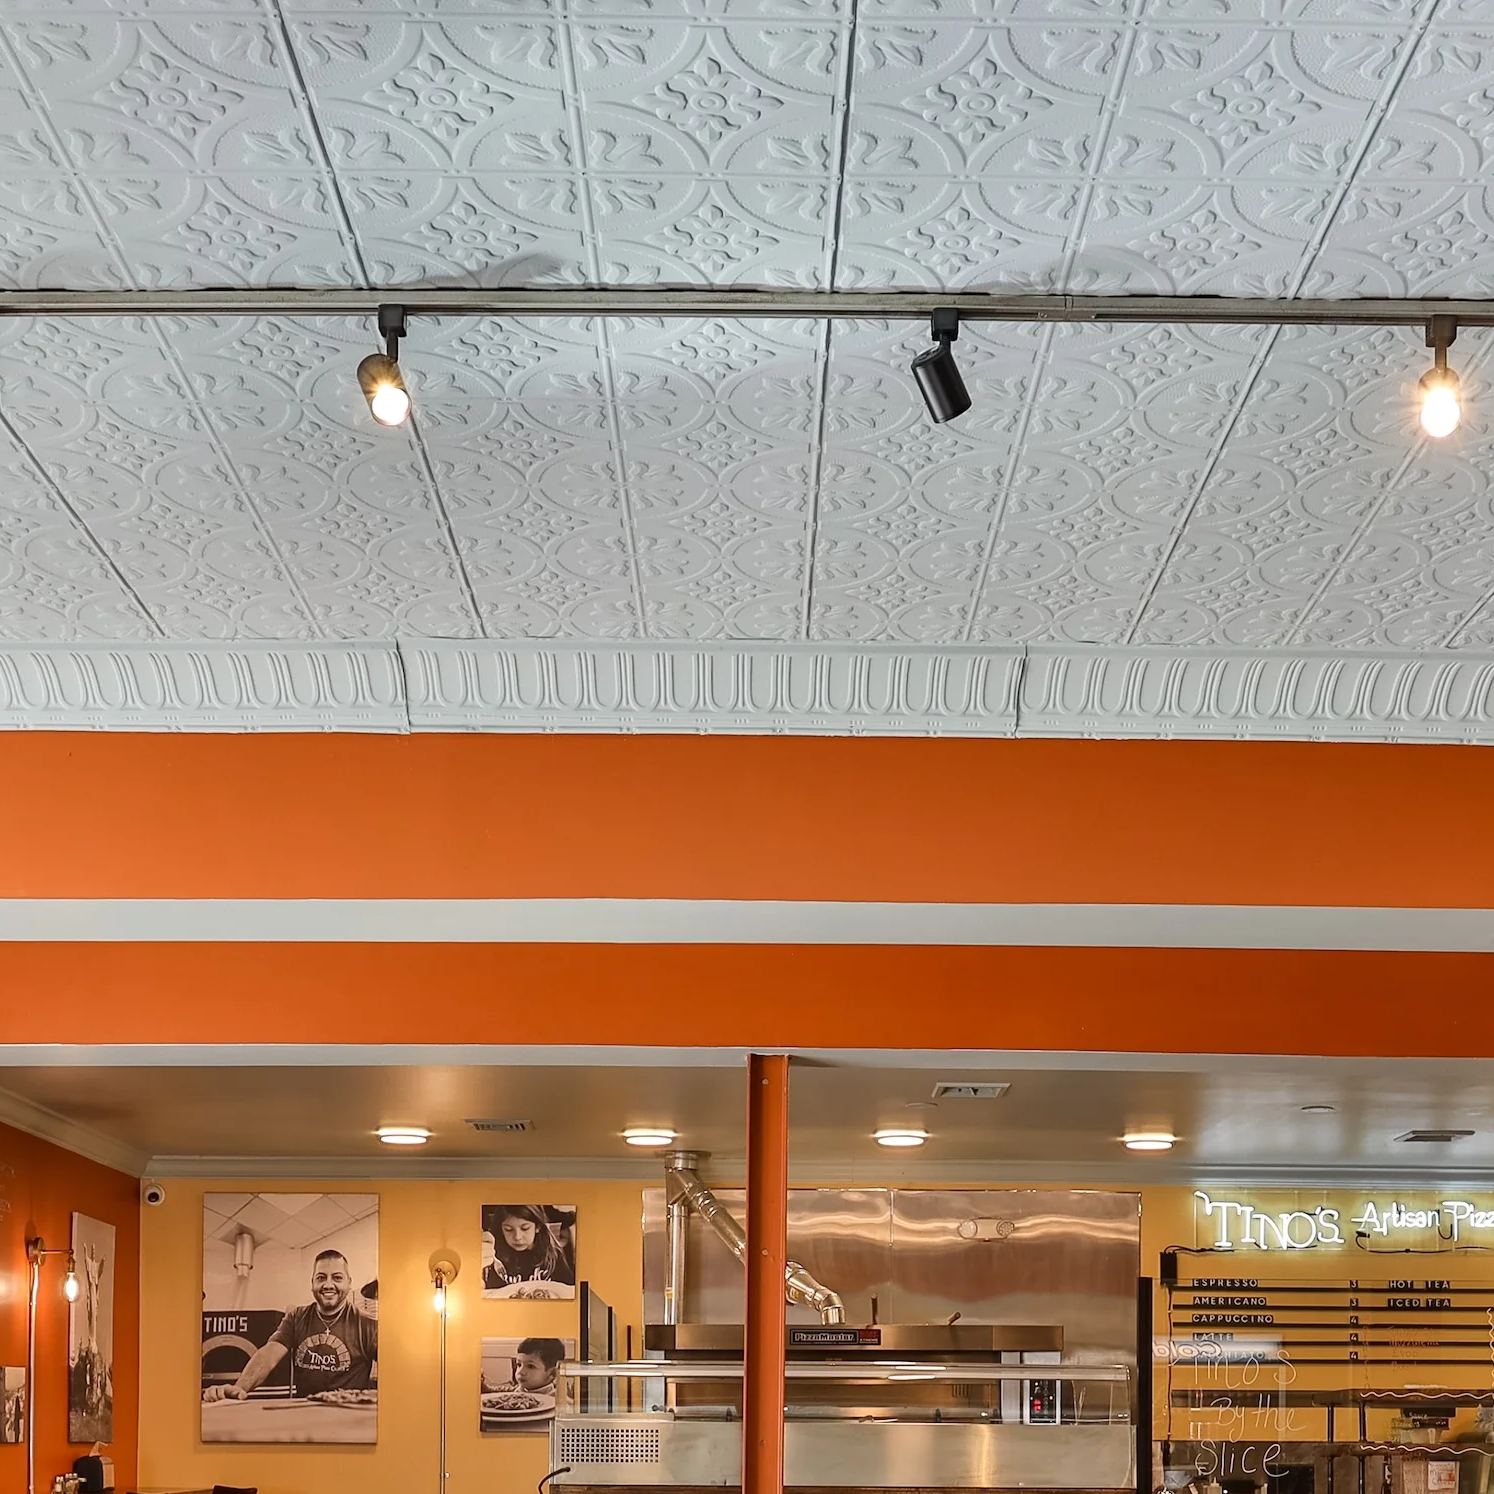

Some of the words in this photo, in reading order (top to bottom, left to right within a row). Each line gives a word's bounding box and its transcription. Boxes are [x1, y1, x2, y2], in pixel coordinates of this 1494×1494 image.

[1193, 1190, 1345, 1250] TINO'S
[1350, 1201, 1440, 1236] Artisan
[1192, 1279, 1257, 1287] ESPRESSO
[1390, 1280, 1412, 1288] HOT
[1426, 1280, 1449, 1288] TEA
[1194, 1297, 1266, 1306] AMERICANO
[1351, 1299, 1357, 1307] 3
[1389, 1299, 1420, 1307] ICED
[1427, 1299, 1450, 1307] TEA
[204, 1315, 248, 1333] TINO'S
[1192, 1314, 1273, 1323] CAPPUCCINO
[1350, 1317, 1357, 1325] 4
[1194, 1333, 1232, 1341] LATTE
[1350, 1333, 1357, 1342] 4
[1350, 1352, 1357, 1360] 4
[1210, 1397, 1246, 1443] By
[1252, 1393, 1307, 1432] the
[1195, 1438, 1290, 1477] Slice
